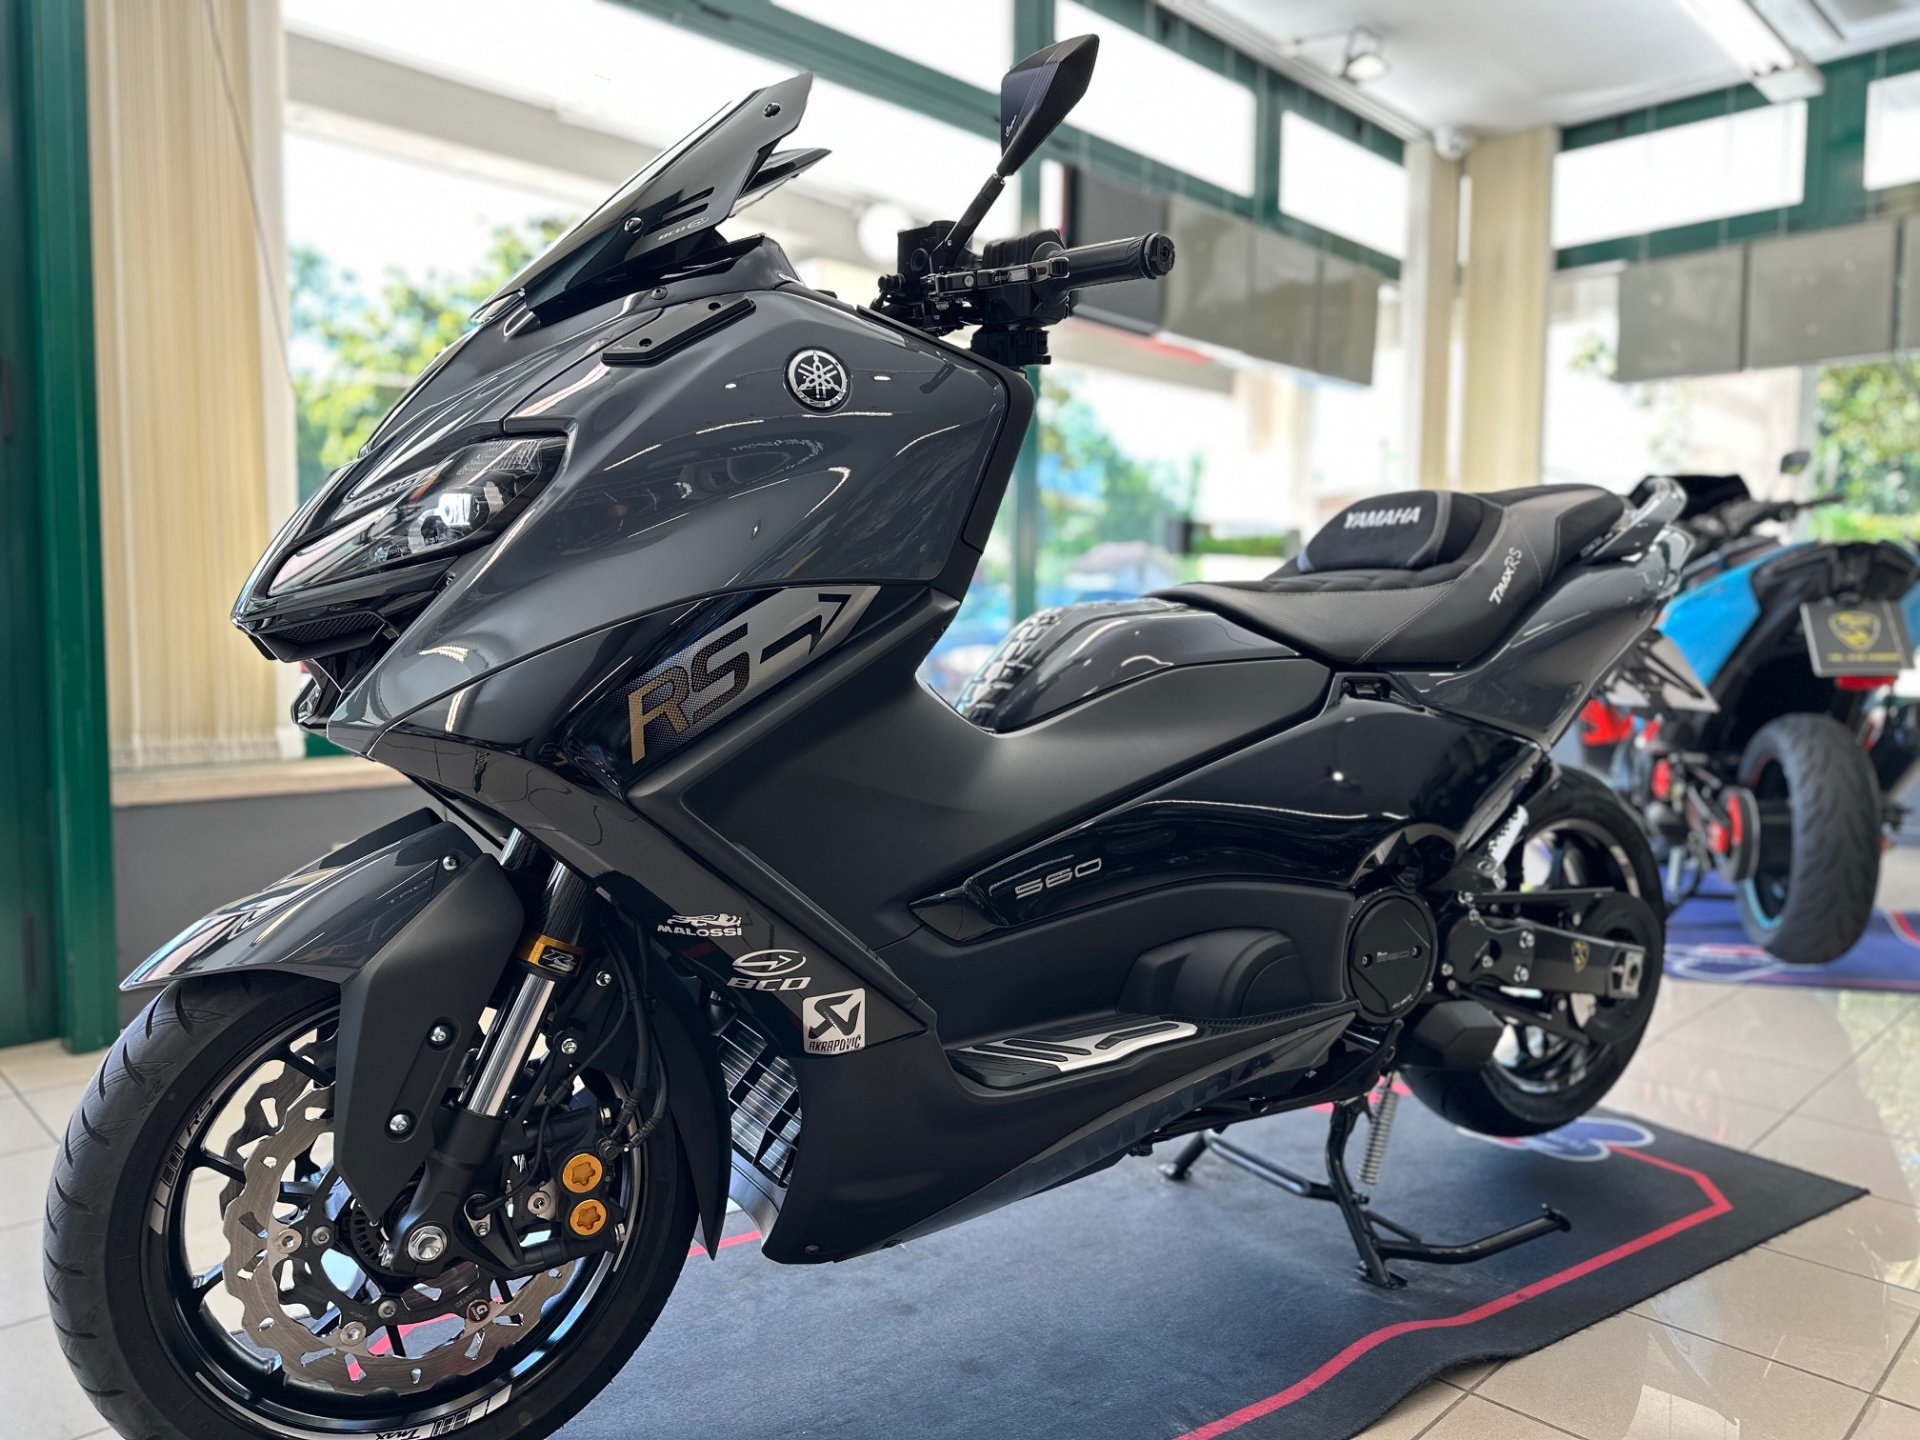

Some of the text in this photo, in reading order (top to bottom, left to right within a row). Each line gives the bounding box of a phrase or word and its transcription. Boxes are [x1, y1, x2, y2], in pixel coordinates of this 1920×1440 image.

[1344, 506, 1422, 529] YAMAHA
[628, 622, 750, 765] RS
[1015, 858, 1102, 899] 560
[657, 924, 742, 937] MALOSSI
[726, 976, 812, 991] BCD
[187, 1097, 214, 1138] RS
